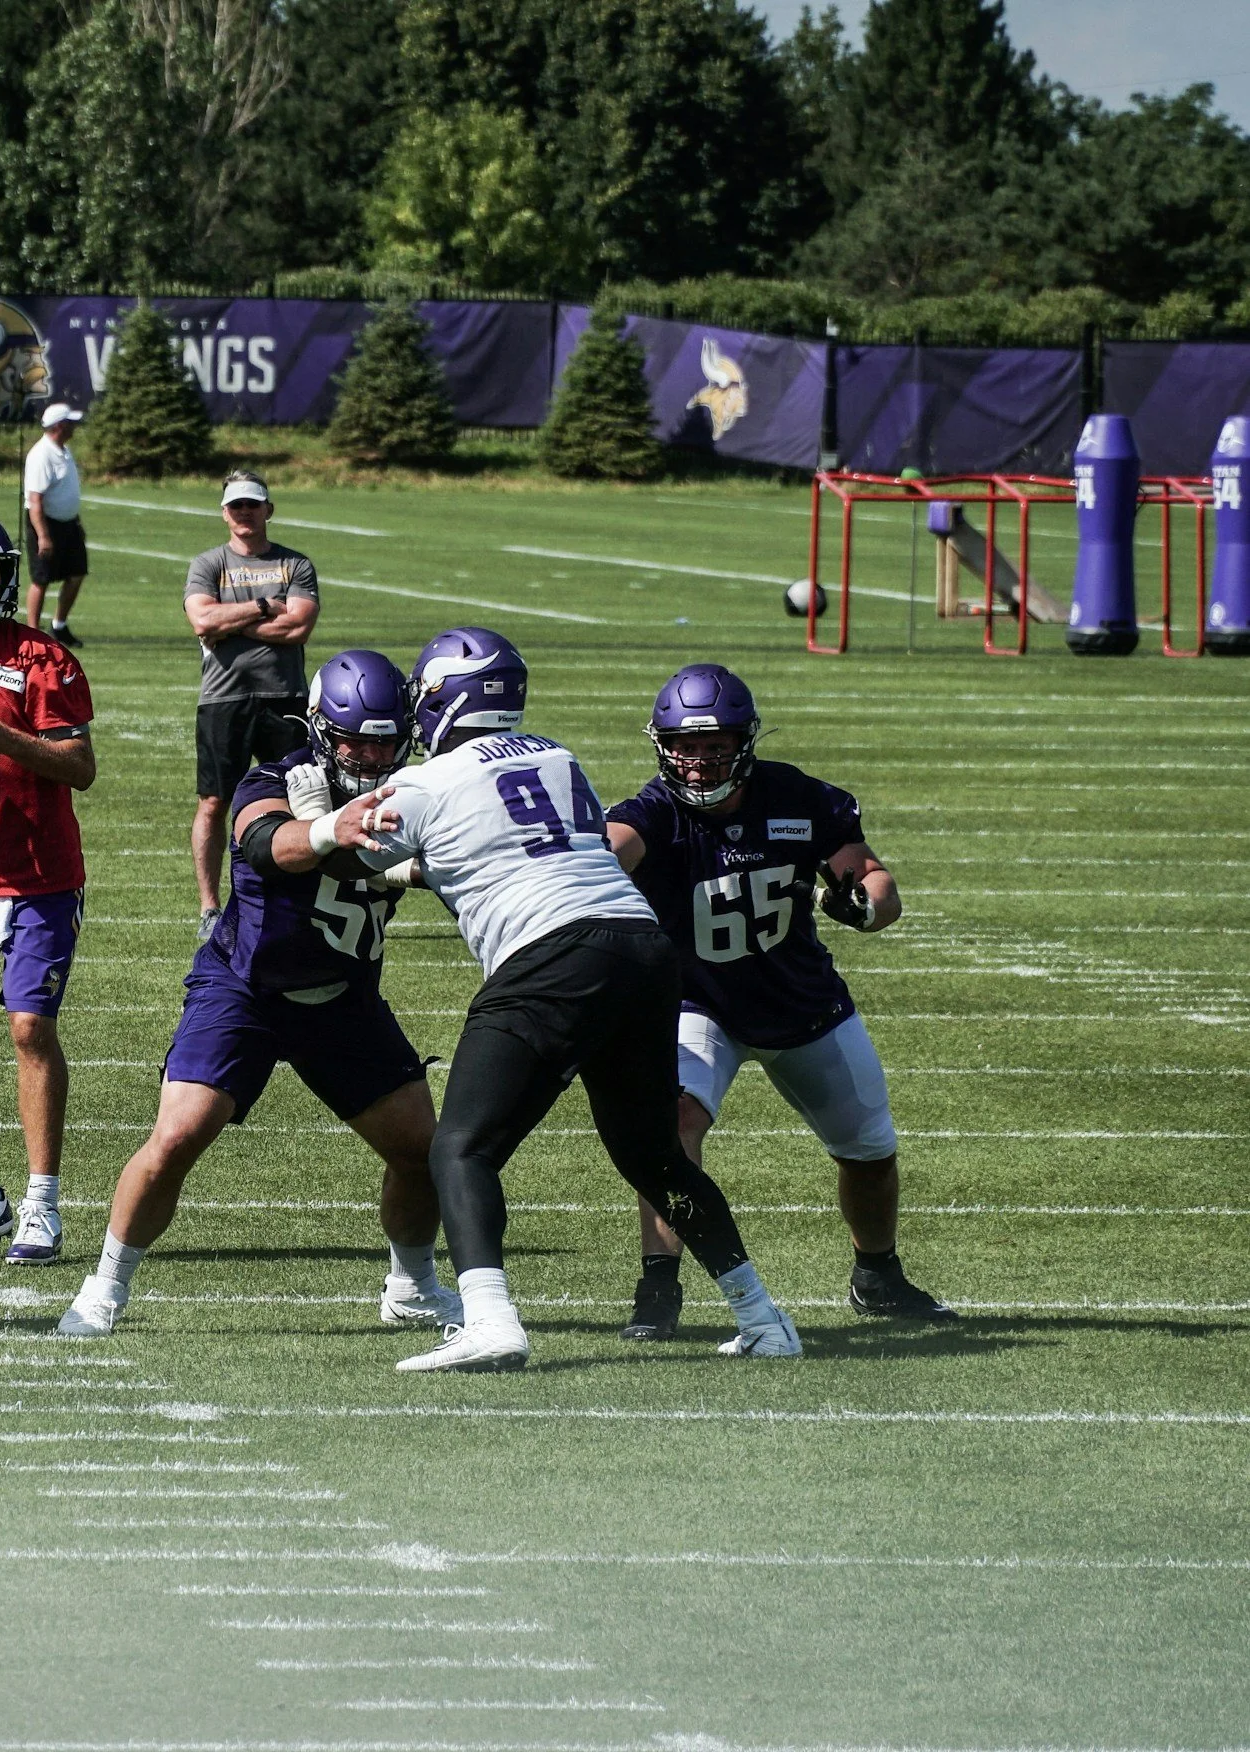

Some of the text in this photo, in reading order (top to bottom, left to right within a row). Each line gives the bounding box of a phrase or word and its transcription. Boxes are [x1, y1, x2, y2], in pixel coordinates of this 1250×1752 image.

[69, 319, 228, 330] MINOTA
[83, 336, 277, 393] VNGS
[1075, 478, 1096, 510] 4
[471, 734, 563, 764] JOHNSO
[496, 761, 612, 858] 94
[770, 825, 807, 836] verizon
[692, 863, 796, 964] 65
